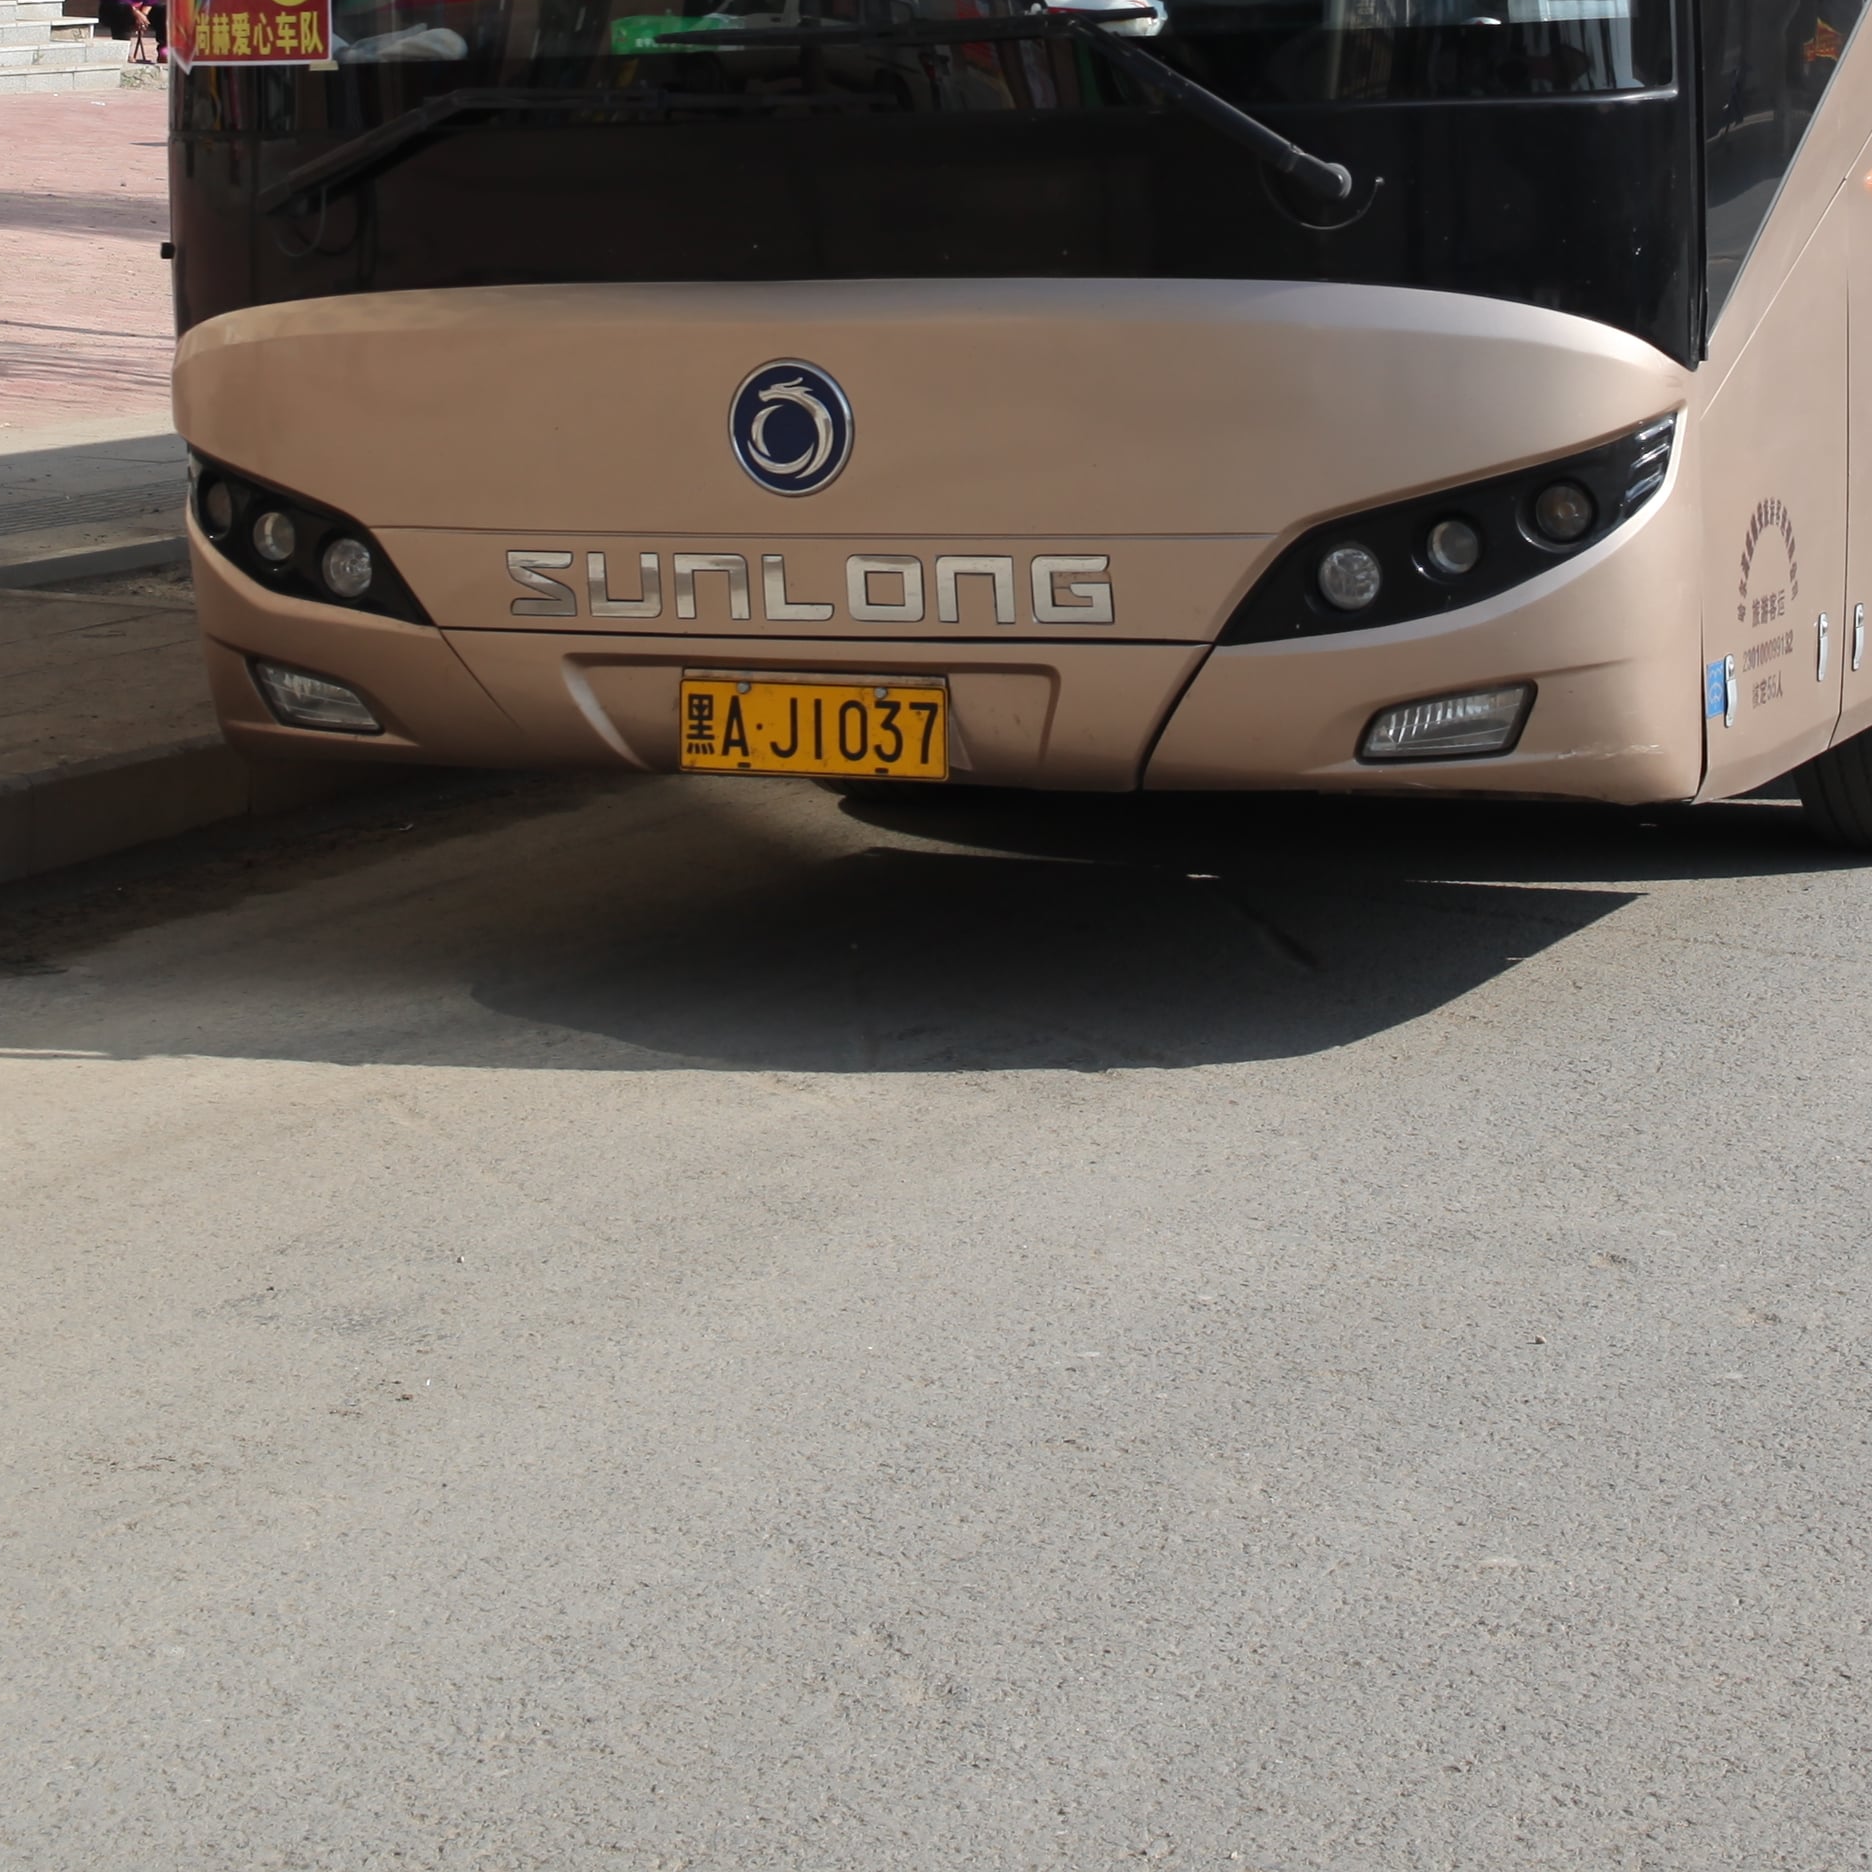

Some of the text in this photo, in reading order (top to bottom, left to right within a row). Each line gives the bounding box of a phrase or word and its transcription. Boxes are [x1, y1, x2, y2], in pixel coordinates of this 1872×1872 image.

[195, 11, 324, 56] 尚赫爱心车队
[506, 550, 1115, 624] SUNLONG
